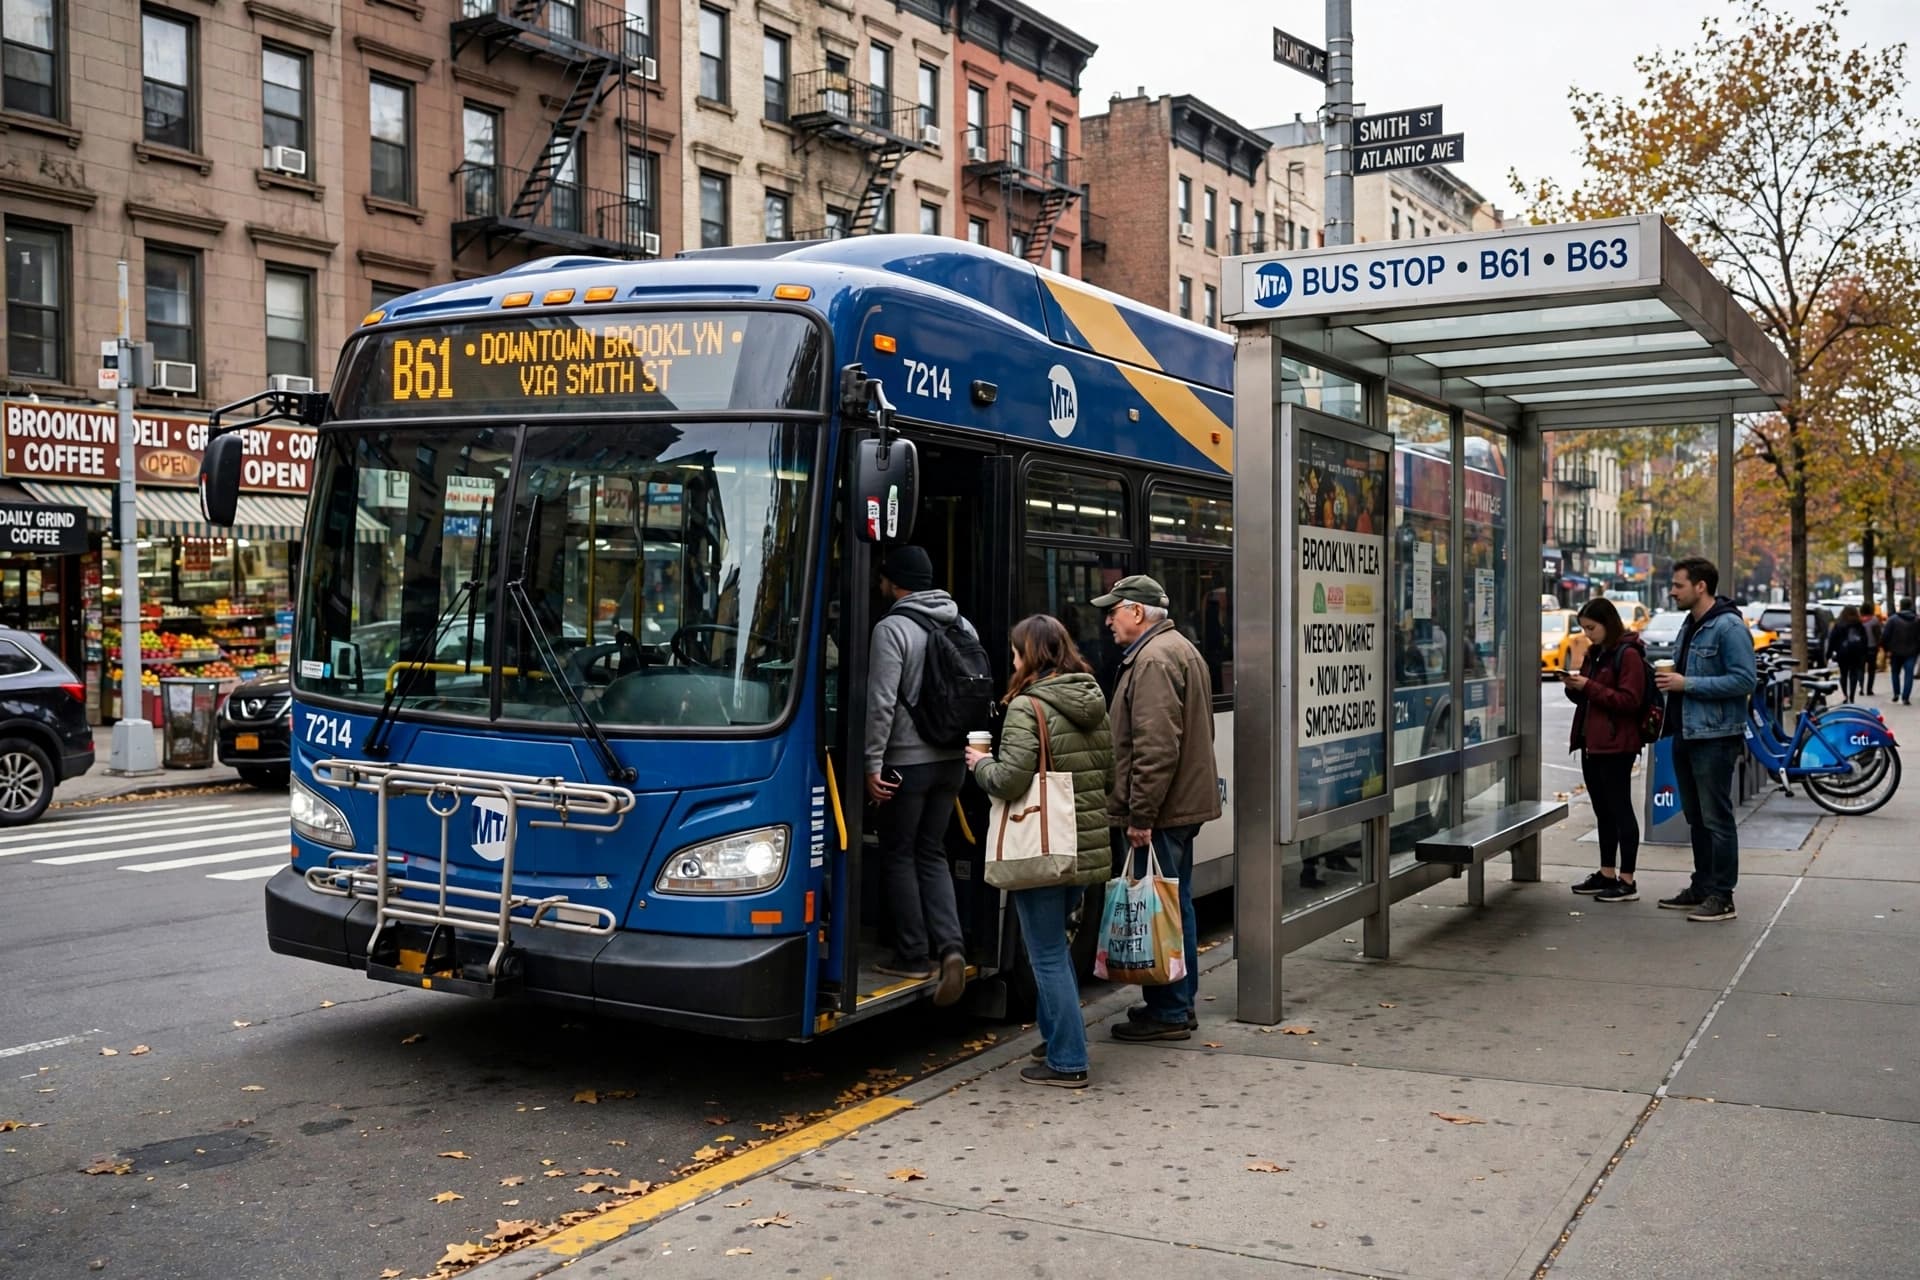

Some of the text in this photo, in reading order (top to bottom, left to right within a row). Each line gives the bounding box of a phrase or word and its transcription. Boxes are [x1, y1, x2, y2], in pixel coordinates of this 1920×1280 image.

[1360, 112, 1434, 142] SMITH ST
[1360, 142, 1455, 170] ATLANTIC AVE
[1254, 238, 1628, 300] MTA BUS STOP B61 B63
[393, 321, 723, 399] B61 DOWNTOWN BROOKLYN
[520, 360, 672, 396] VIA SMITH ST
[903, 358, 952, 400] 7214
[8, 407, 115, 443] BROOKLYN
[186, 423, 271, 456] GRERY
[24, 442, 104, 475] COFFEE
[244, 461, 306, 488] OPEN
[0, 509, 75, 528] DAILY GRIND
[11, 528, 60, 545] COFFEE
[1302, 537, 1380, 575] BROOKLYN FLEA
[1304, 623, 1375, 654] WEEKEND MARKET
[1317, 664, 1366, 696] NOW OPEN
[305, 713, 352, 748] 7214
[1305, 700, 1376, 738] SMORGASBURG
[1850, 734, 1869, 746] citi
[1654, 790, 1673, 807] citi
